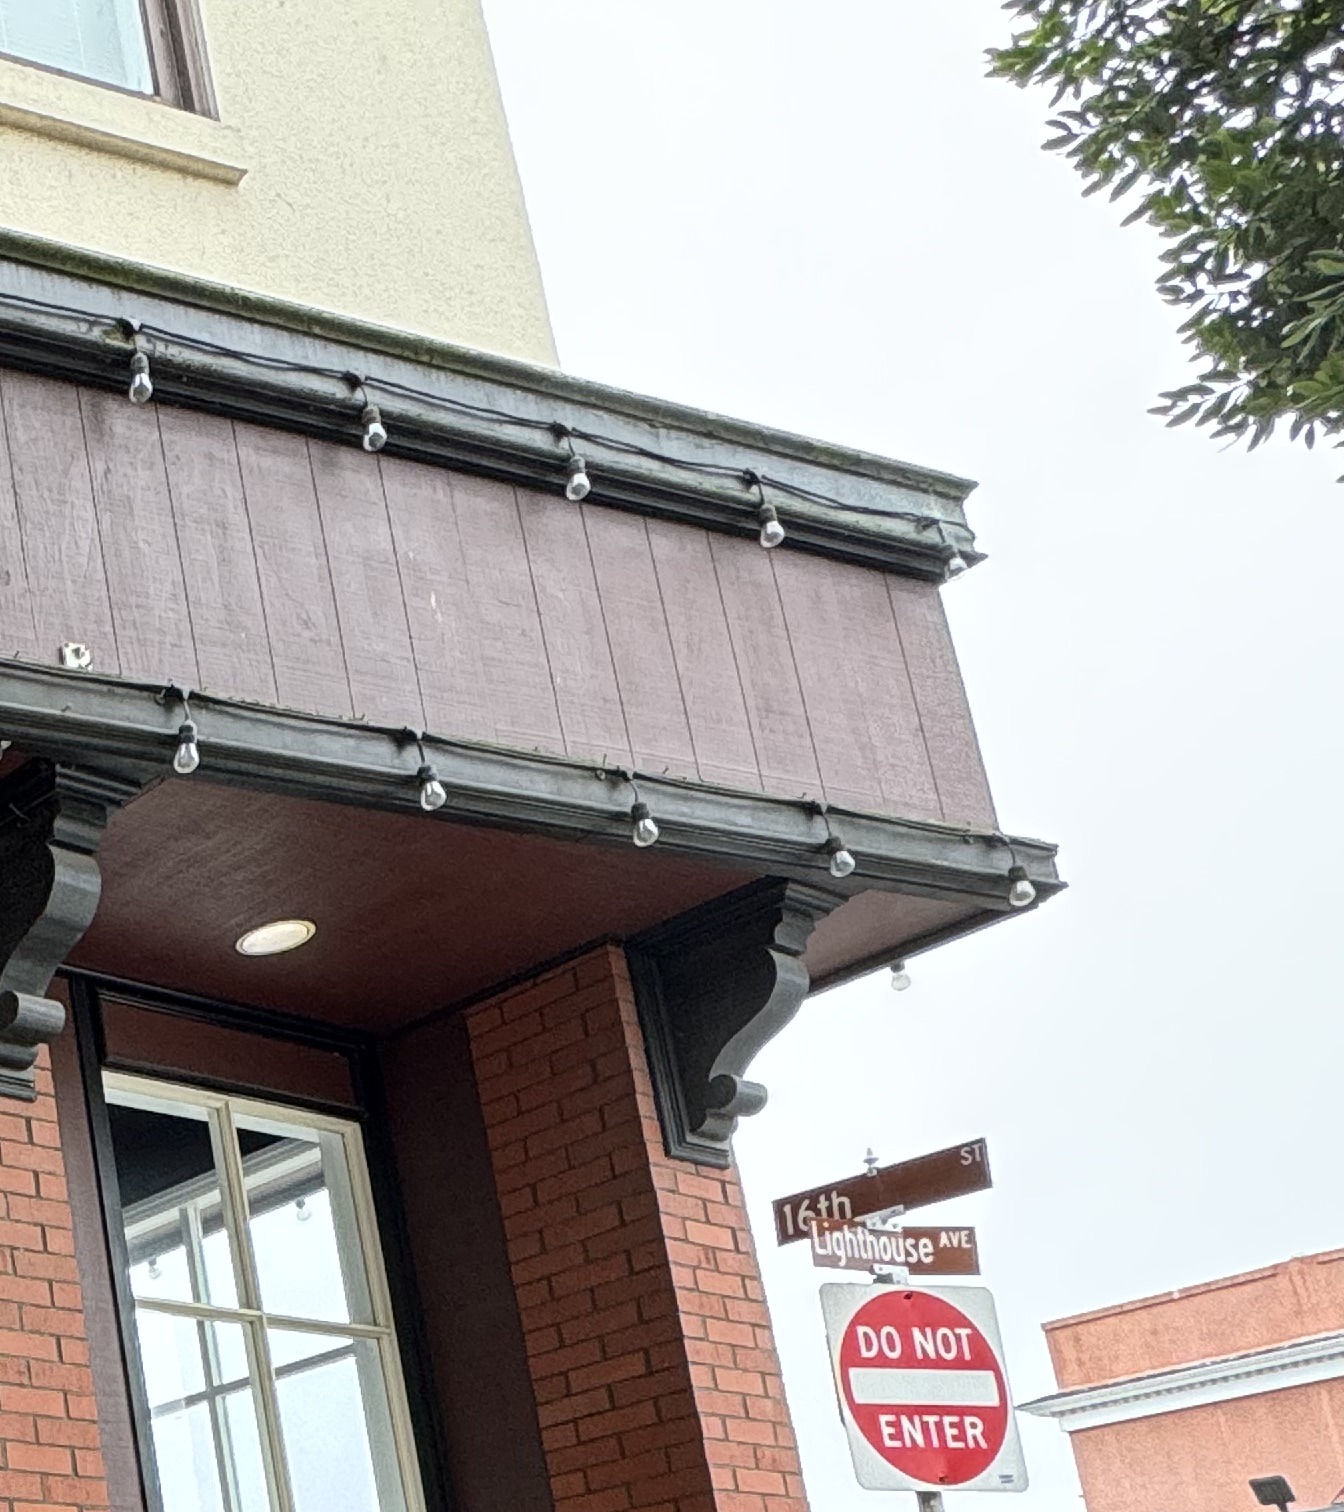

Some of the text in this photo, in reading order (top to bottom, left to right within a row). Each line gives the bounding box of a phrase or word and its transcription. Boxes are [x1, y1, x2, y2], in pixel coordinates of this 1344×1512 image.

[782, 1143, 983, 1236] 16th ST
[811, 1219, 973, 1267] Lighthouse AVE
[856, 1324, 974, 1361] DO NOT
[878, 1414, 988, 1450] ENTER
